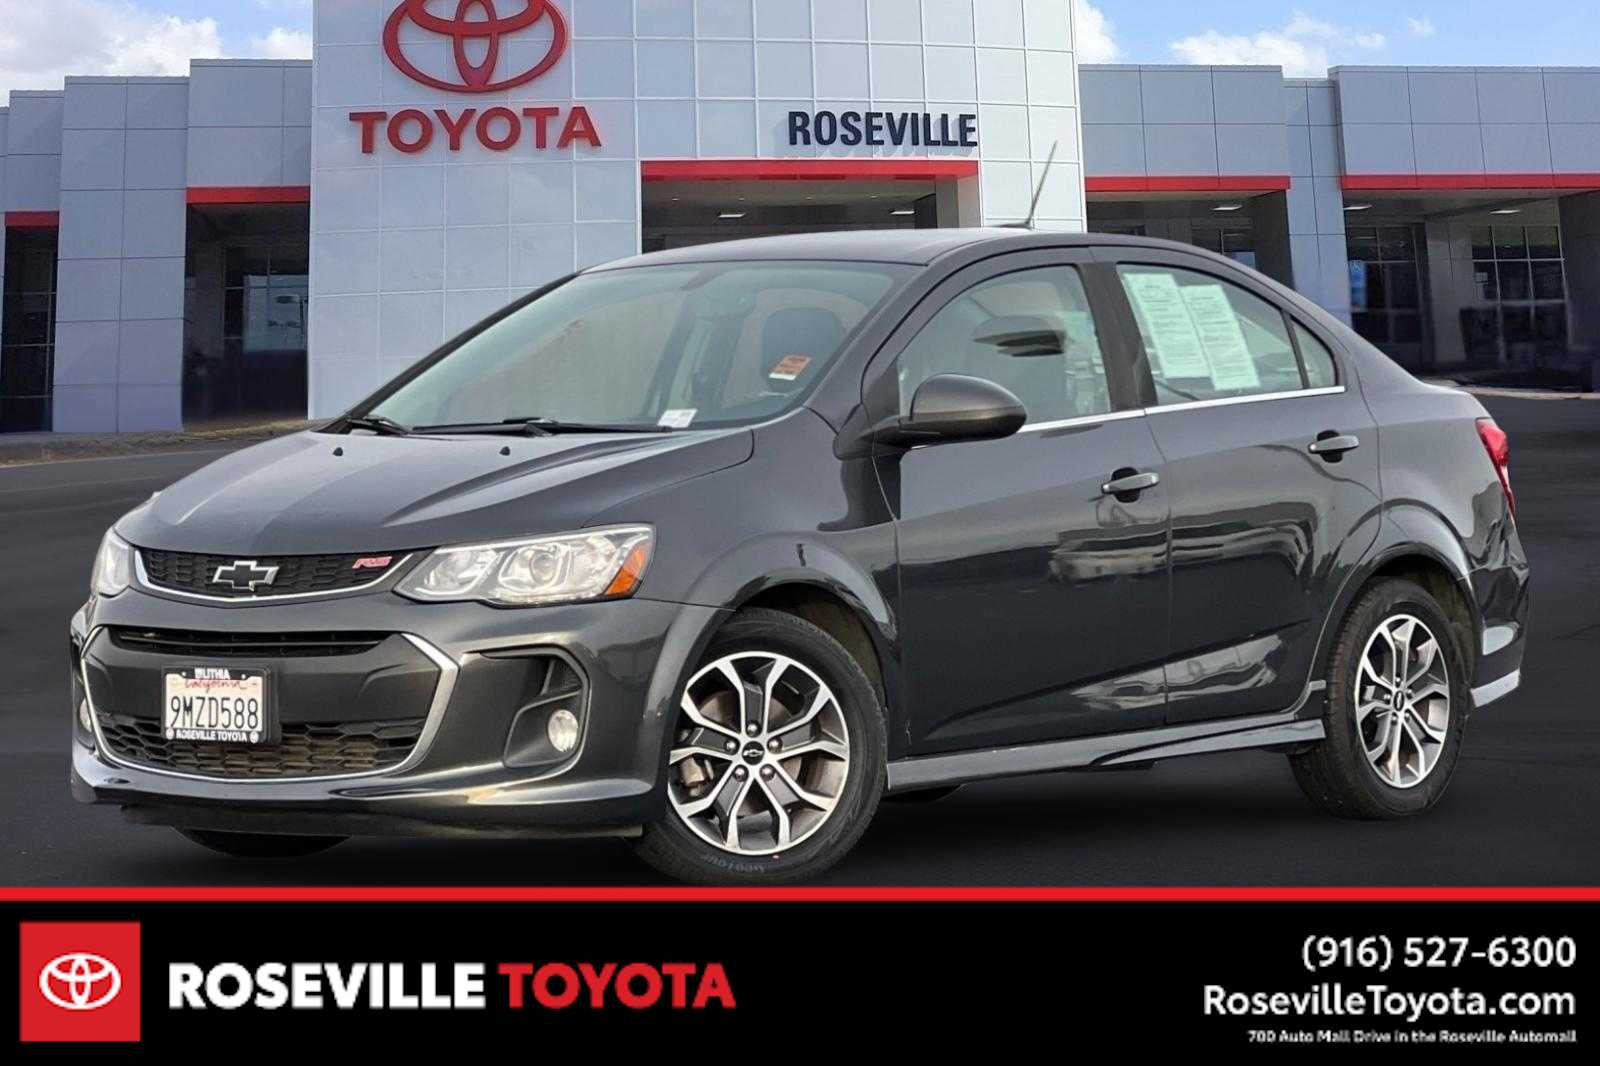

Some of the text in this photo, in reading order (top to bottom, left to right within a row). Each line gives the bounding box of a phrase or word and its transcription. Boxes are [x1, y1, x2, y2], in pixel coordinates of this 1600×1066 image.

[349, 106, 602, 154] TOYOTA
[788, 110, 978, 147] ROSEVILLE
[352, 556, 393, 569] RS
[170, 696, 259, 729] 9MZD588
[176, 730, 248, 742] ROSEVILLE TOYOTA
